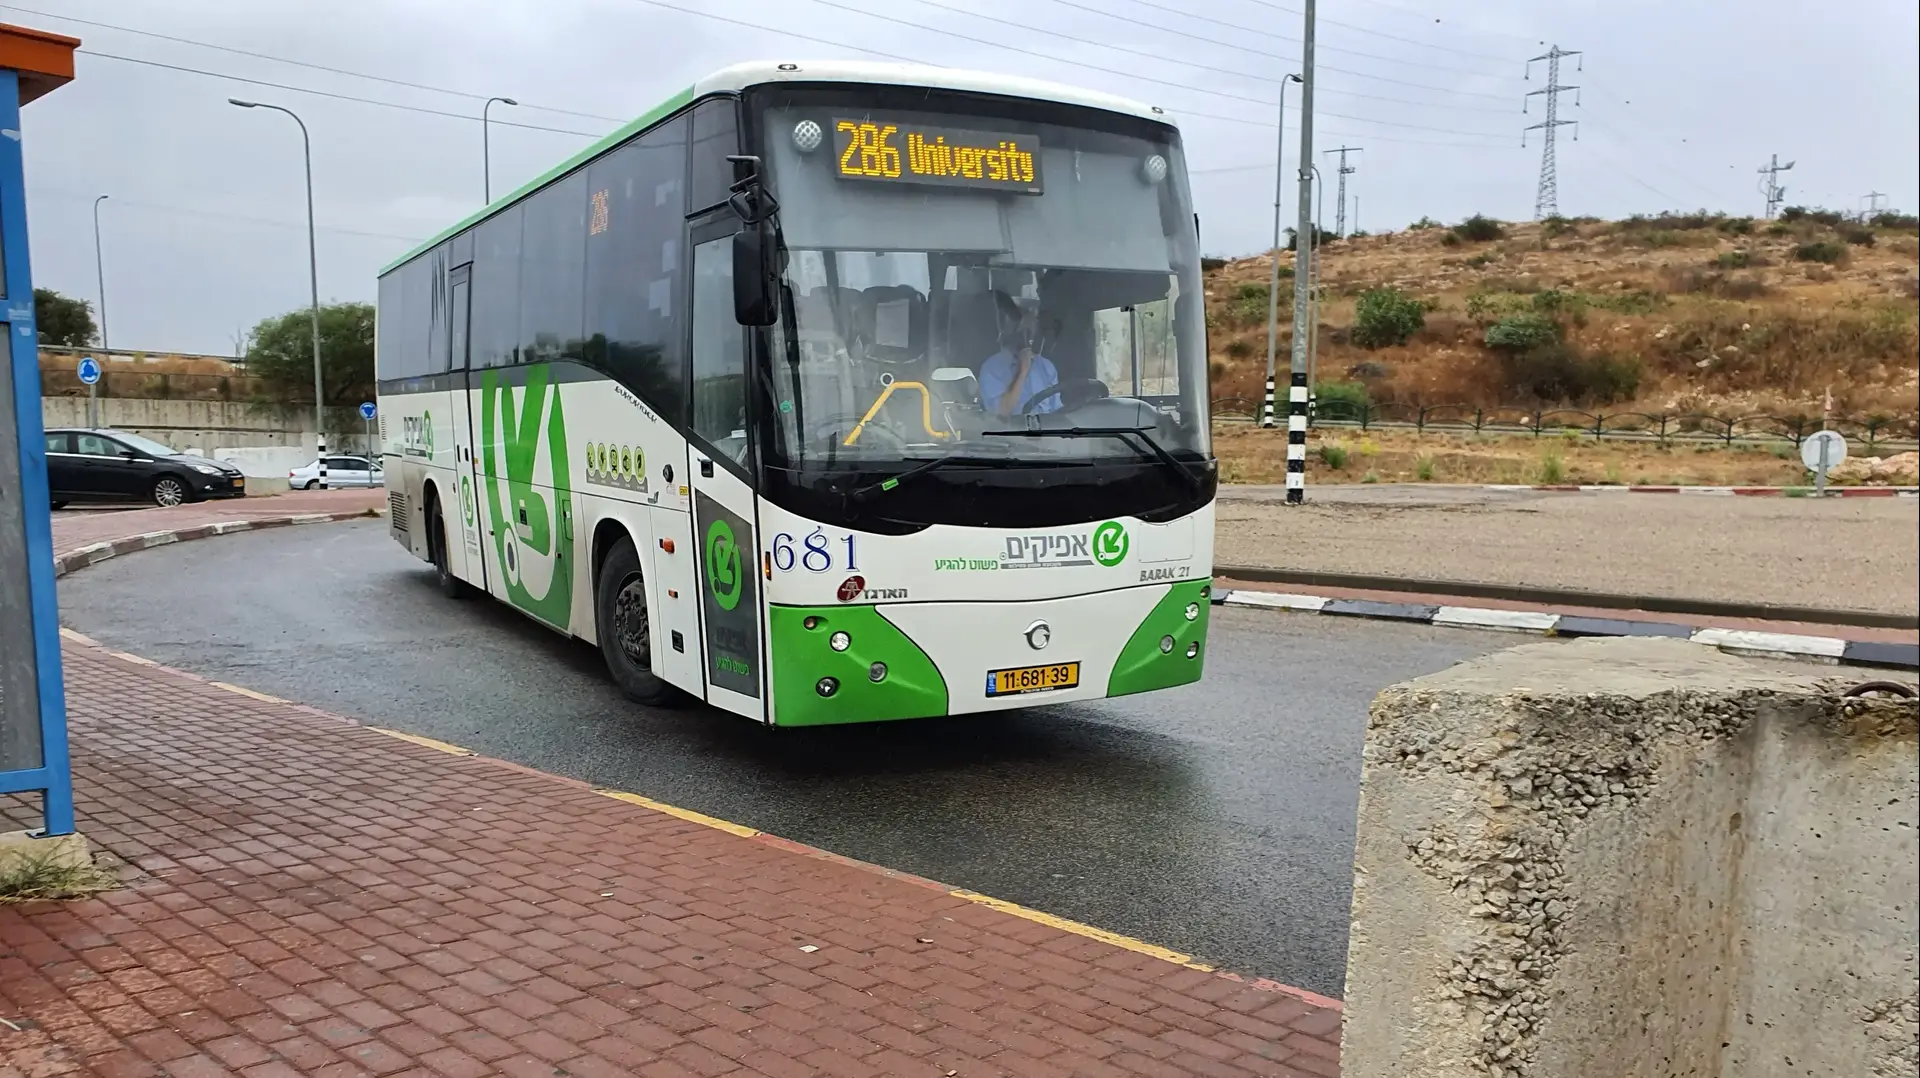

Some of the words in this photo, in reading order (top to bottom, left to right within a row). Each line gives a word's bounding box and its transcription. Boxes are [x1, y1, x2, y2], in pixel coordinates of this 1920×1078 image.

[837, 120, 901, 178] 286
[908, 132, 1034, 183] University
[773, 525, 861, 574] 681
[1006, 534, 1089, 564] אפיקים
[934, 557, 967, 572] להגיע
[969, 558, 998, 571] פשוט
[1140, 566, 1176, 582] BARAK
[1177, 565, 1191, 578] 21
[862, 587, 908, 600] הארגז
